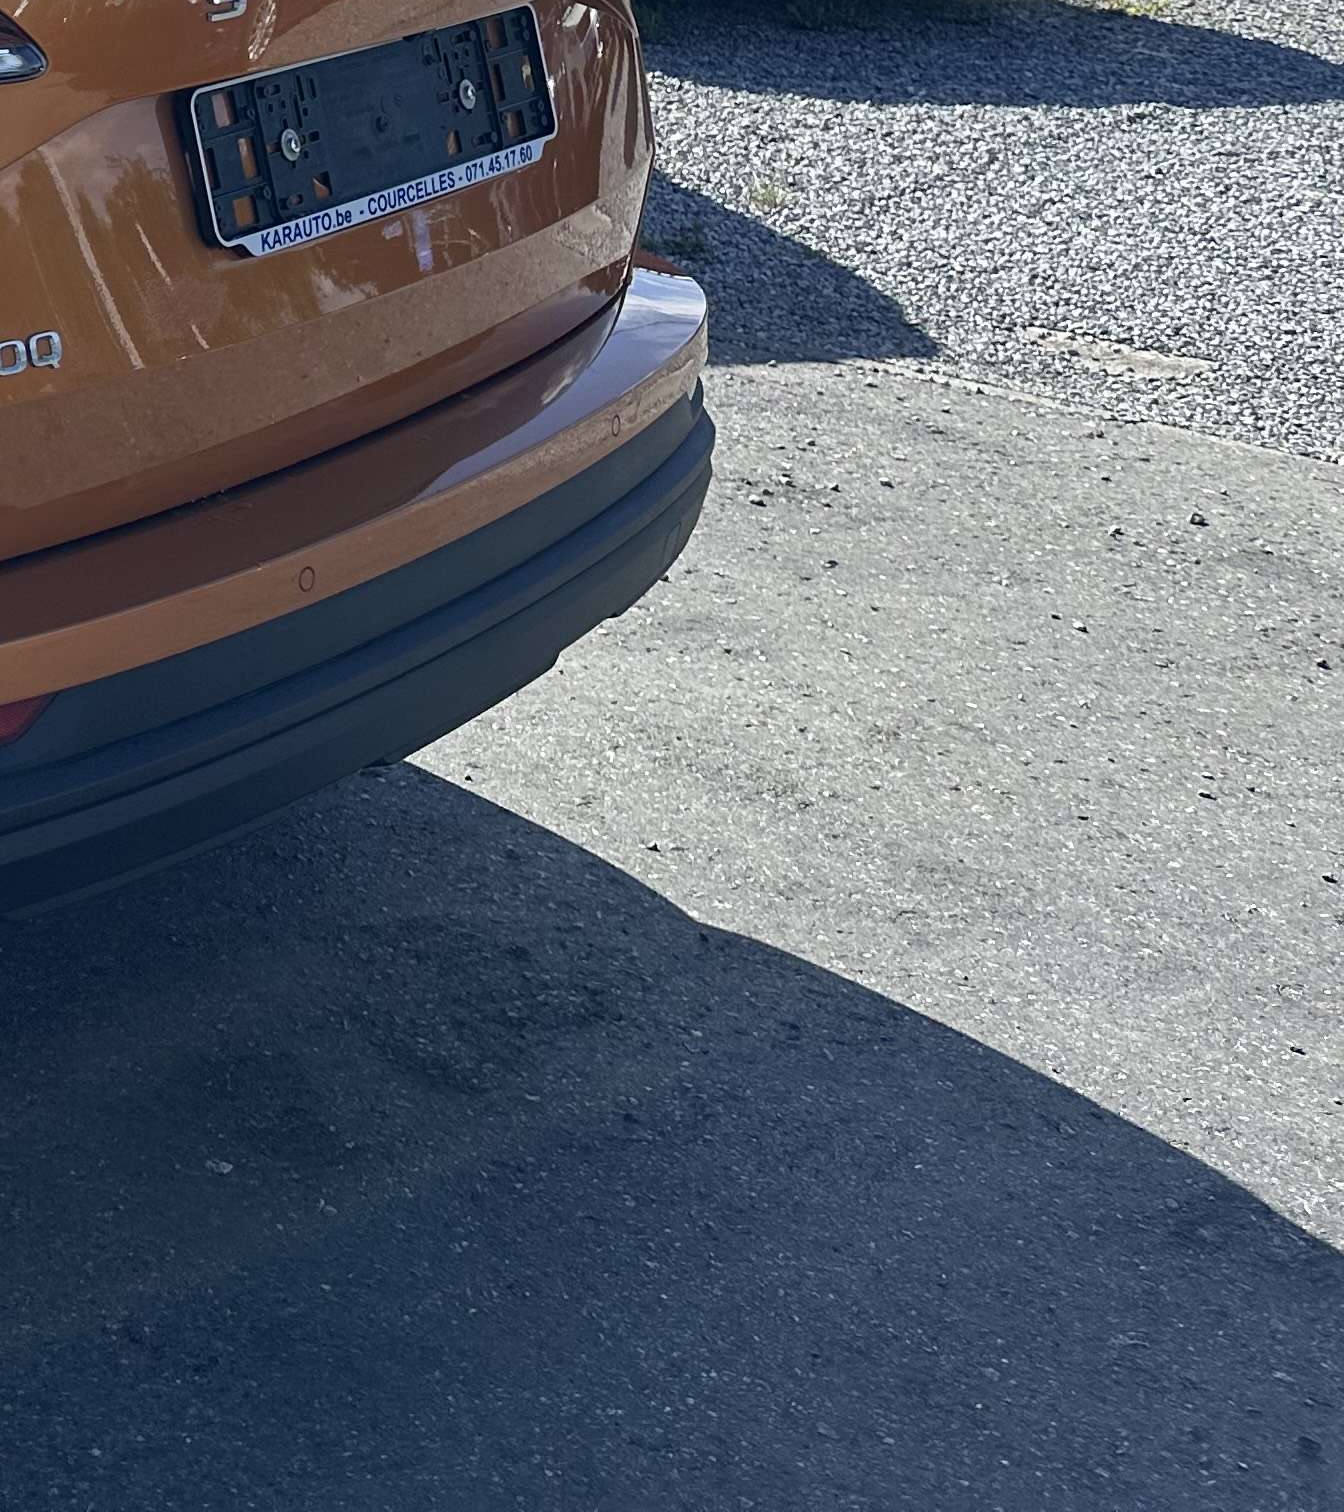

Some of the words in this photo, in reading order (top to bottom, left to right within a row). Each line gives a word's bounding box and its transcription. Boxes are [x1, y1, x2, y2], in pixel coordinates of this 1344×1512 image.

[261, 209, 353, 252] KARAUTO.be
[367, 172, 456, 216] COURCELLES
[465, 144, 533, 183] 071.45.17.60
